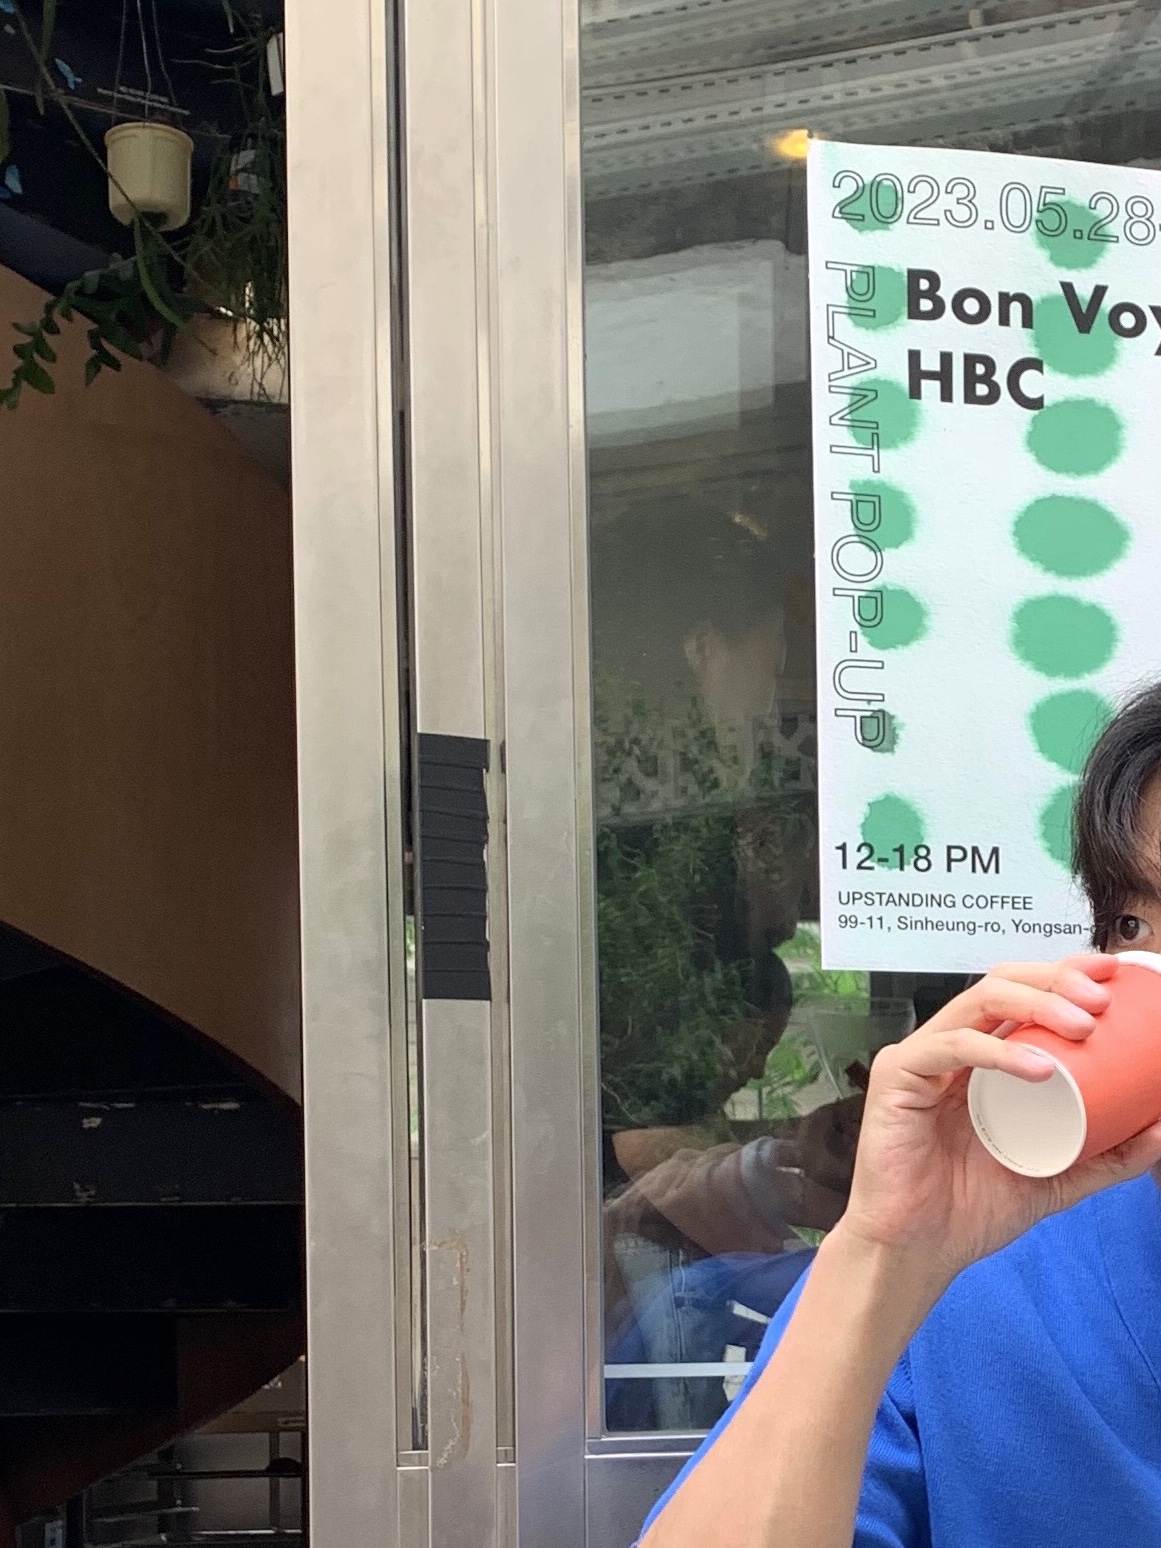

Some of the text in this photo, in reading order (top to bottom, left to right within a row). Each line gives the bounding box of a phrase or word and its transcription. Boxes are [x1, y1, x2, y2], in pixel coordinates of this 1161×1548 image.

[907, 268, 1033, 329] Bon
[908, 350, 1044, 411] HBC
[825, 261, 886, 750] PLANT POP-UP
[835, 843, 1000, 874] 12-18 PM
[838, 891, 1033, 911] UPSTANDING COFFEE
[838, 915, 891, 933] 99-11,
[897, 916, 1006, 936] Sinheung-ro,
